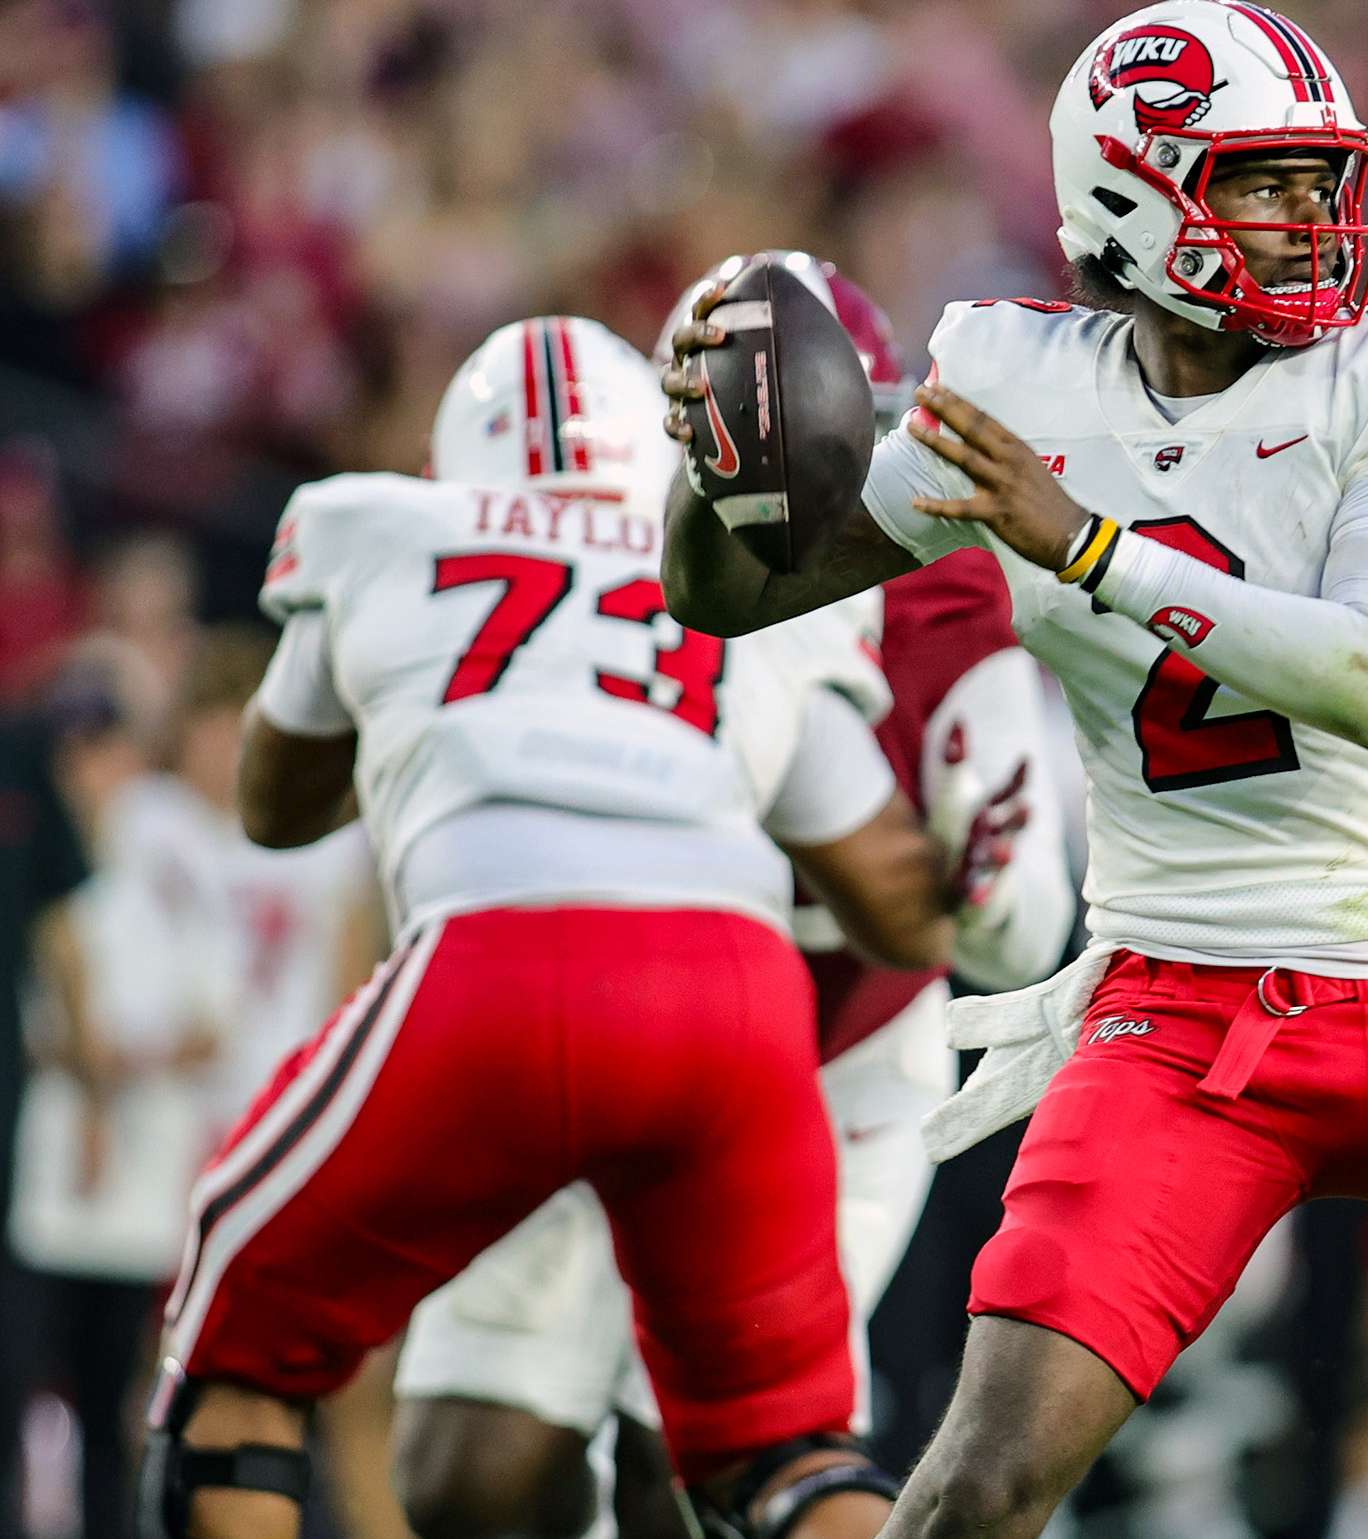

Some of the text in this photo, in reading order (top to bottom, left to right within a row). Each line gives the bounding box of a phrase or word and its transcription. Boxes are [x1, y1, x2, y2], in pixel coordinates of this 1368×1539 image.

[1109, 36, 1189, 73] WKU
[1167, 609, 1202, 637] WKU
[432, 551, 726, 738] 73
[1091, 514, 1301, 793] 2
[1088, 1014, 1155, 1046] Tops
